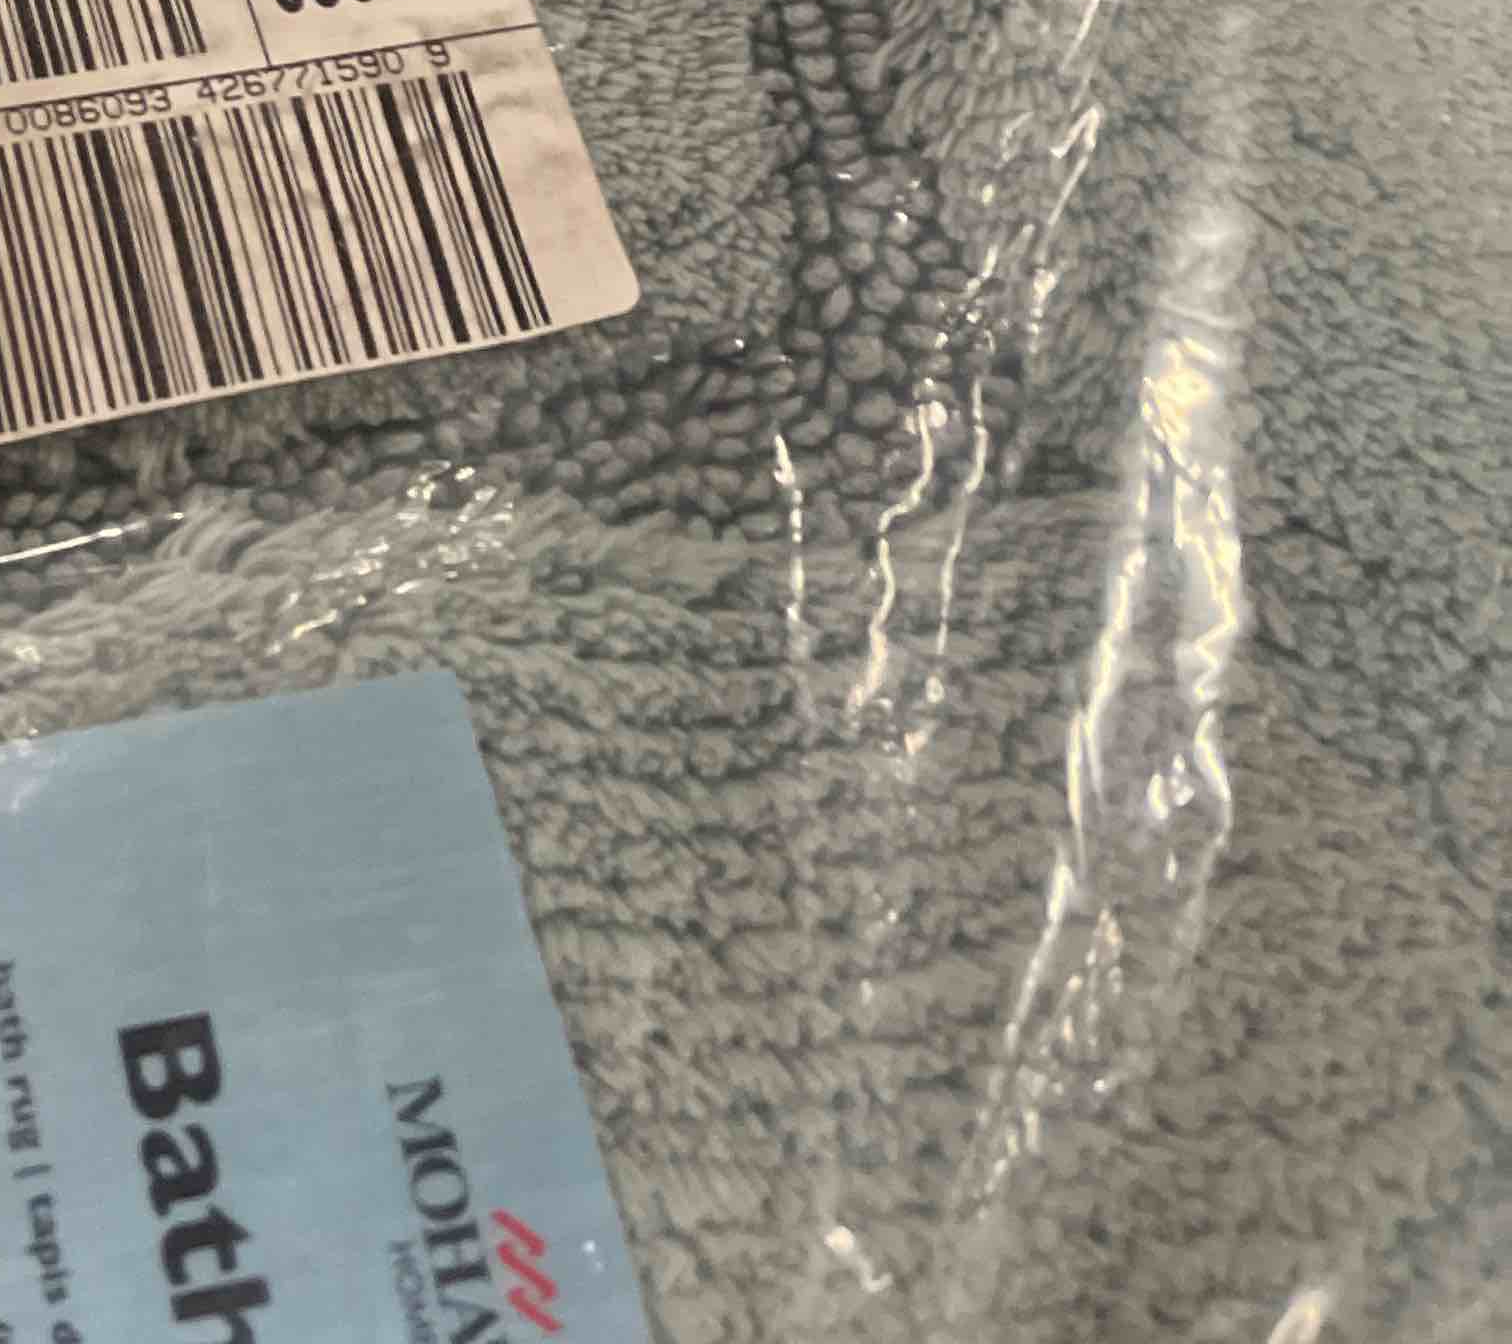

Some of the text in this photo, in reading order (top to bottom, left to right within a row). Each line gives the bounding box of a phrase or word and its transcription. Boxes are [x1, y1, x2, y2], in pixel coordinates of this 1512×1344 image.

[4, 88, 174, 137] 0086093
[195, 47, 406, 105] 426771590
[428, 38, 452, 68] 9
[6, 1074, 42, 1151] rug
[25, 1192, 73, 1304] tapis
[117, 1011, 271, 1344] Bath
[386, 1075, 506, 1344] MOHA
